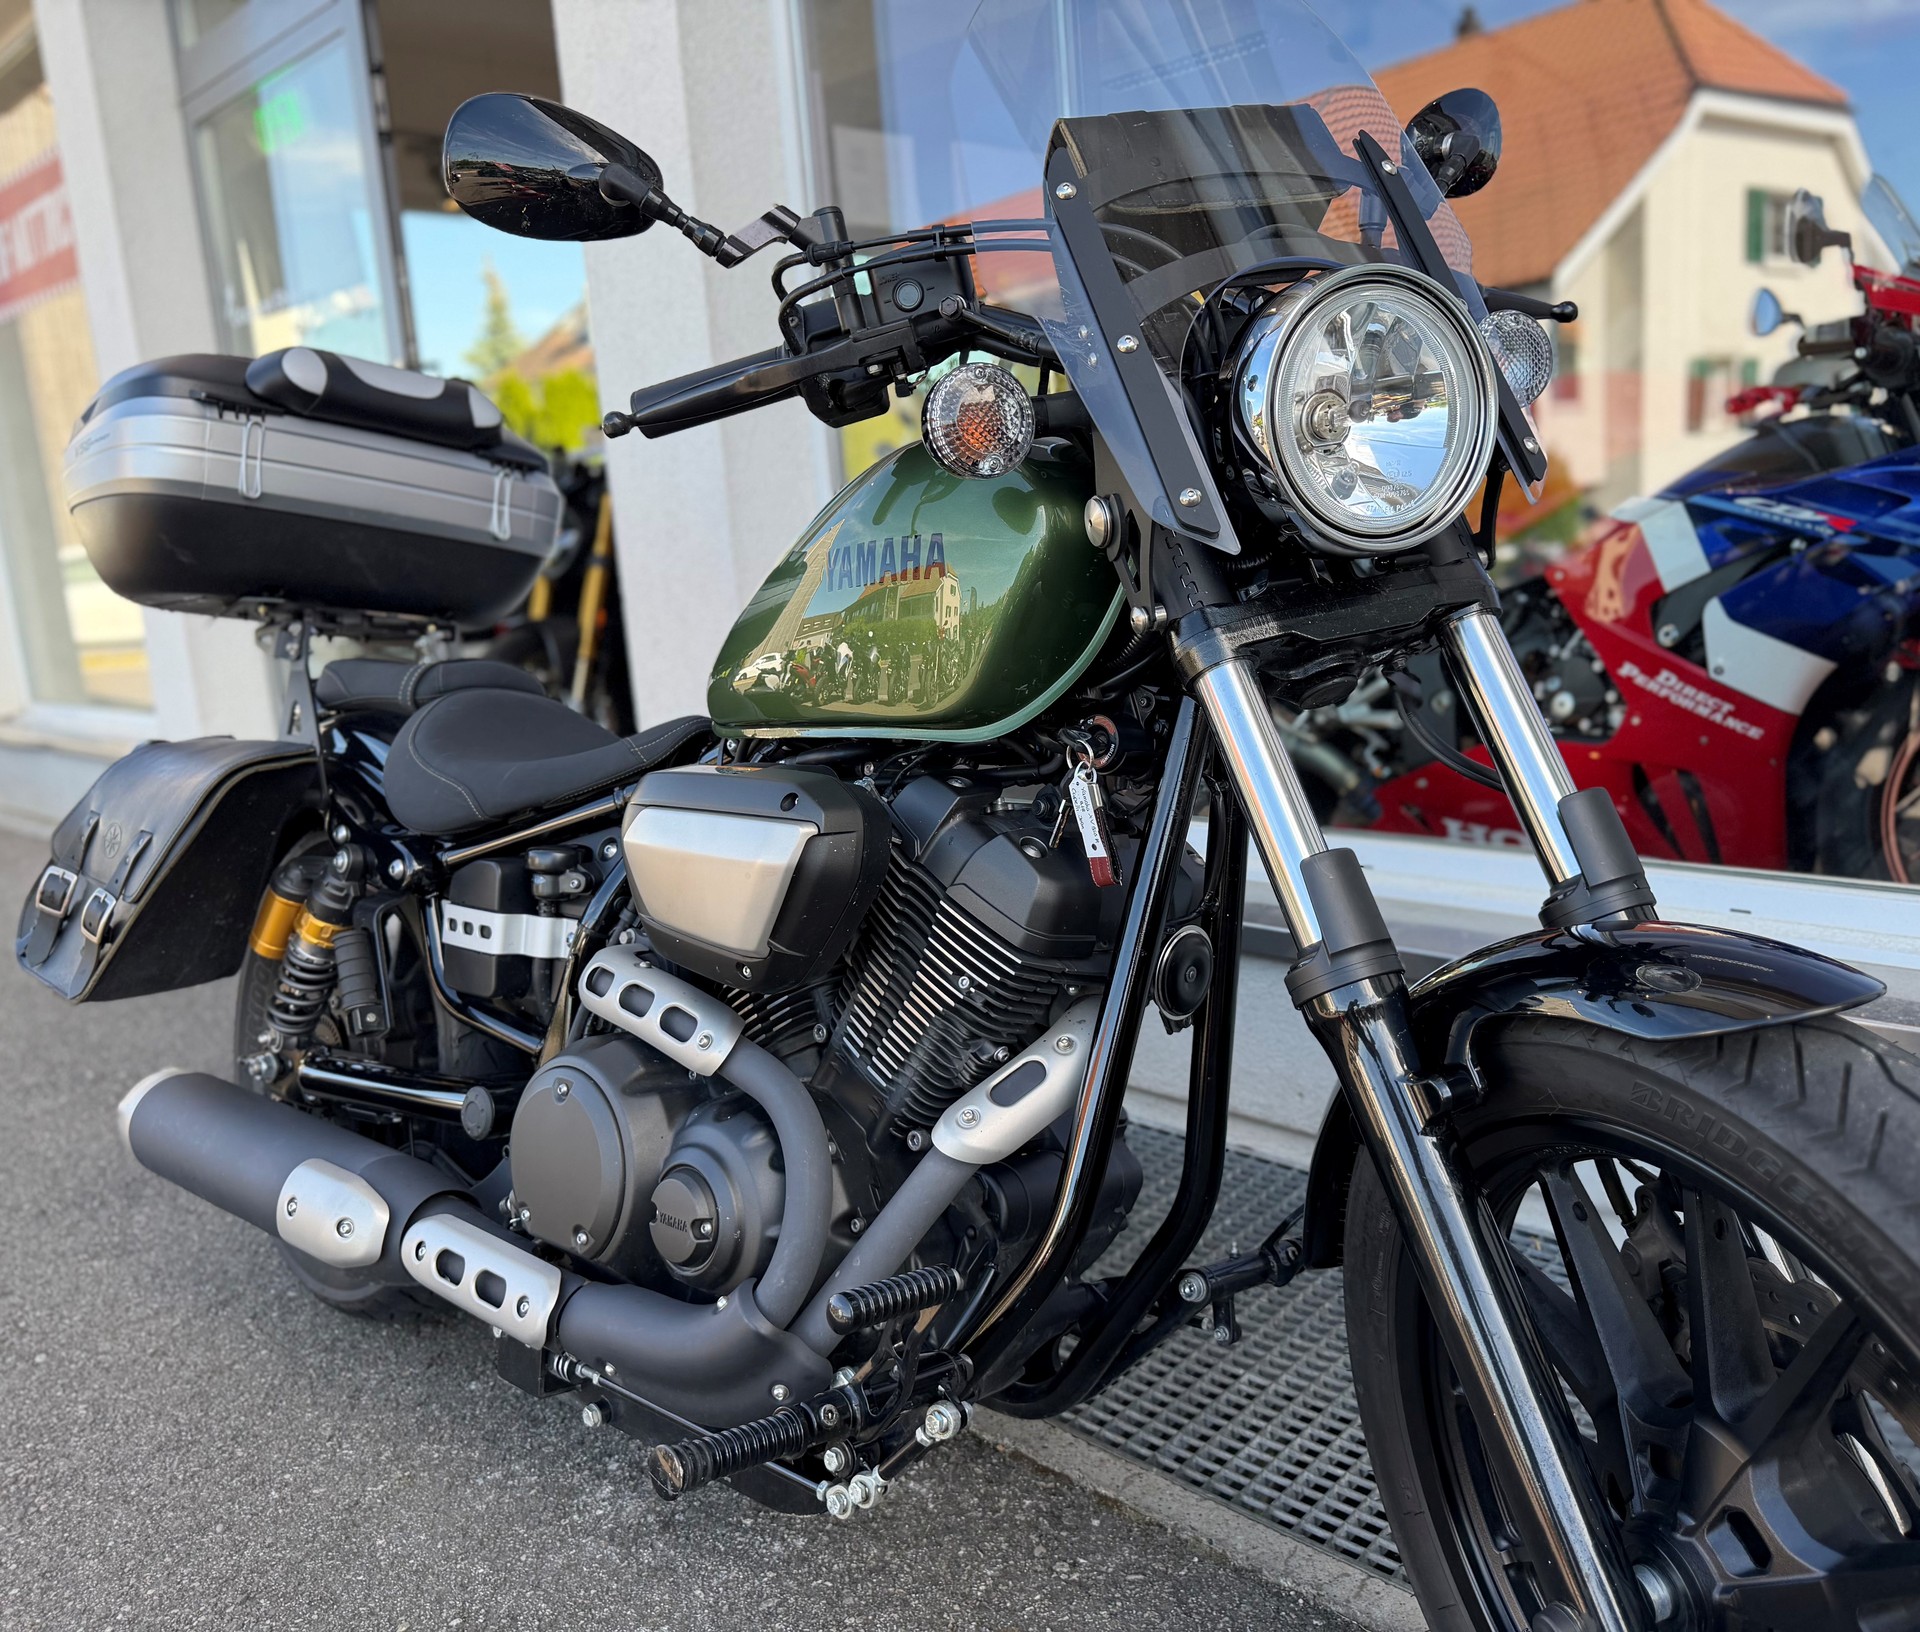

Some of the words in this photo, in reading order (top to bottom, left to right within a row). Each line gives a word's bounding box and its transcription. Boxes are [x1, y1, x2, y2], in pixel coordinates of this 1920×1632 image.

[825, 532, 947, 593] YAMAHA
[1616, 660, 1765, 740] PERFORMANCE
[1655, 668, 1736, 714] DIRECT
[1100, 743, 1116, 765] IGNITION
[659, 1211, 688, 1233] YAMAHA
